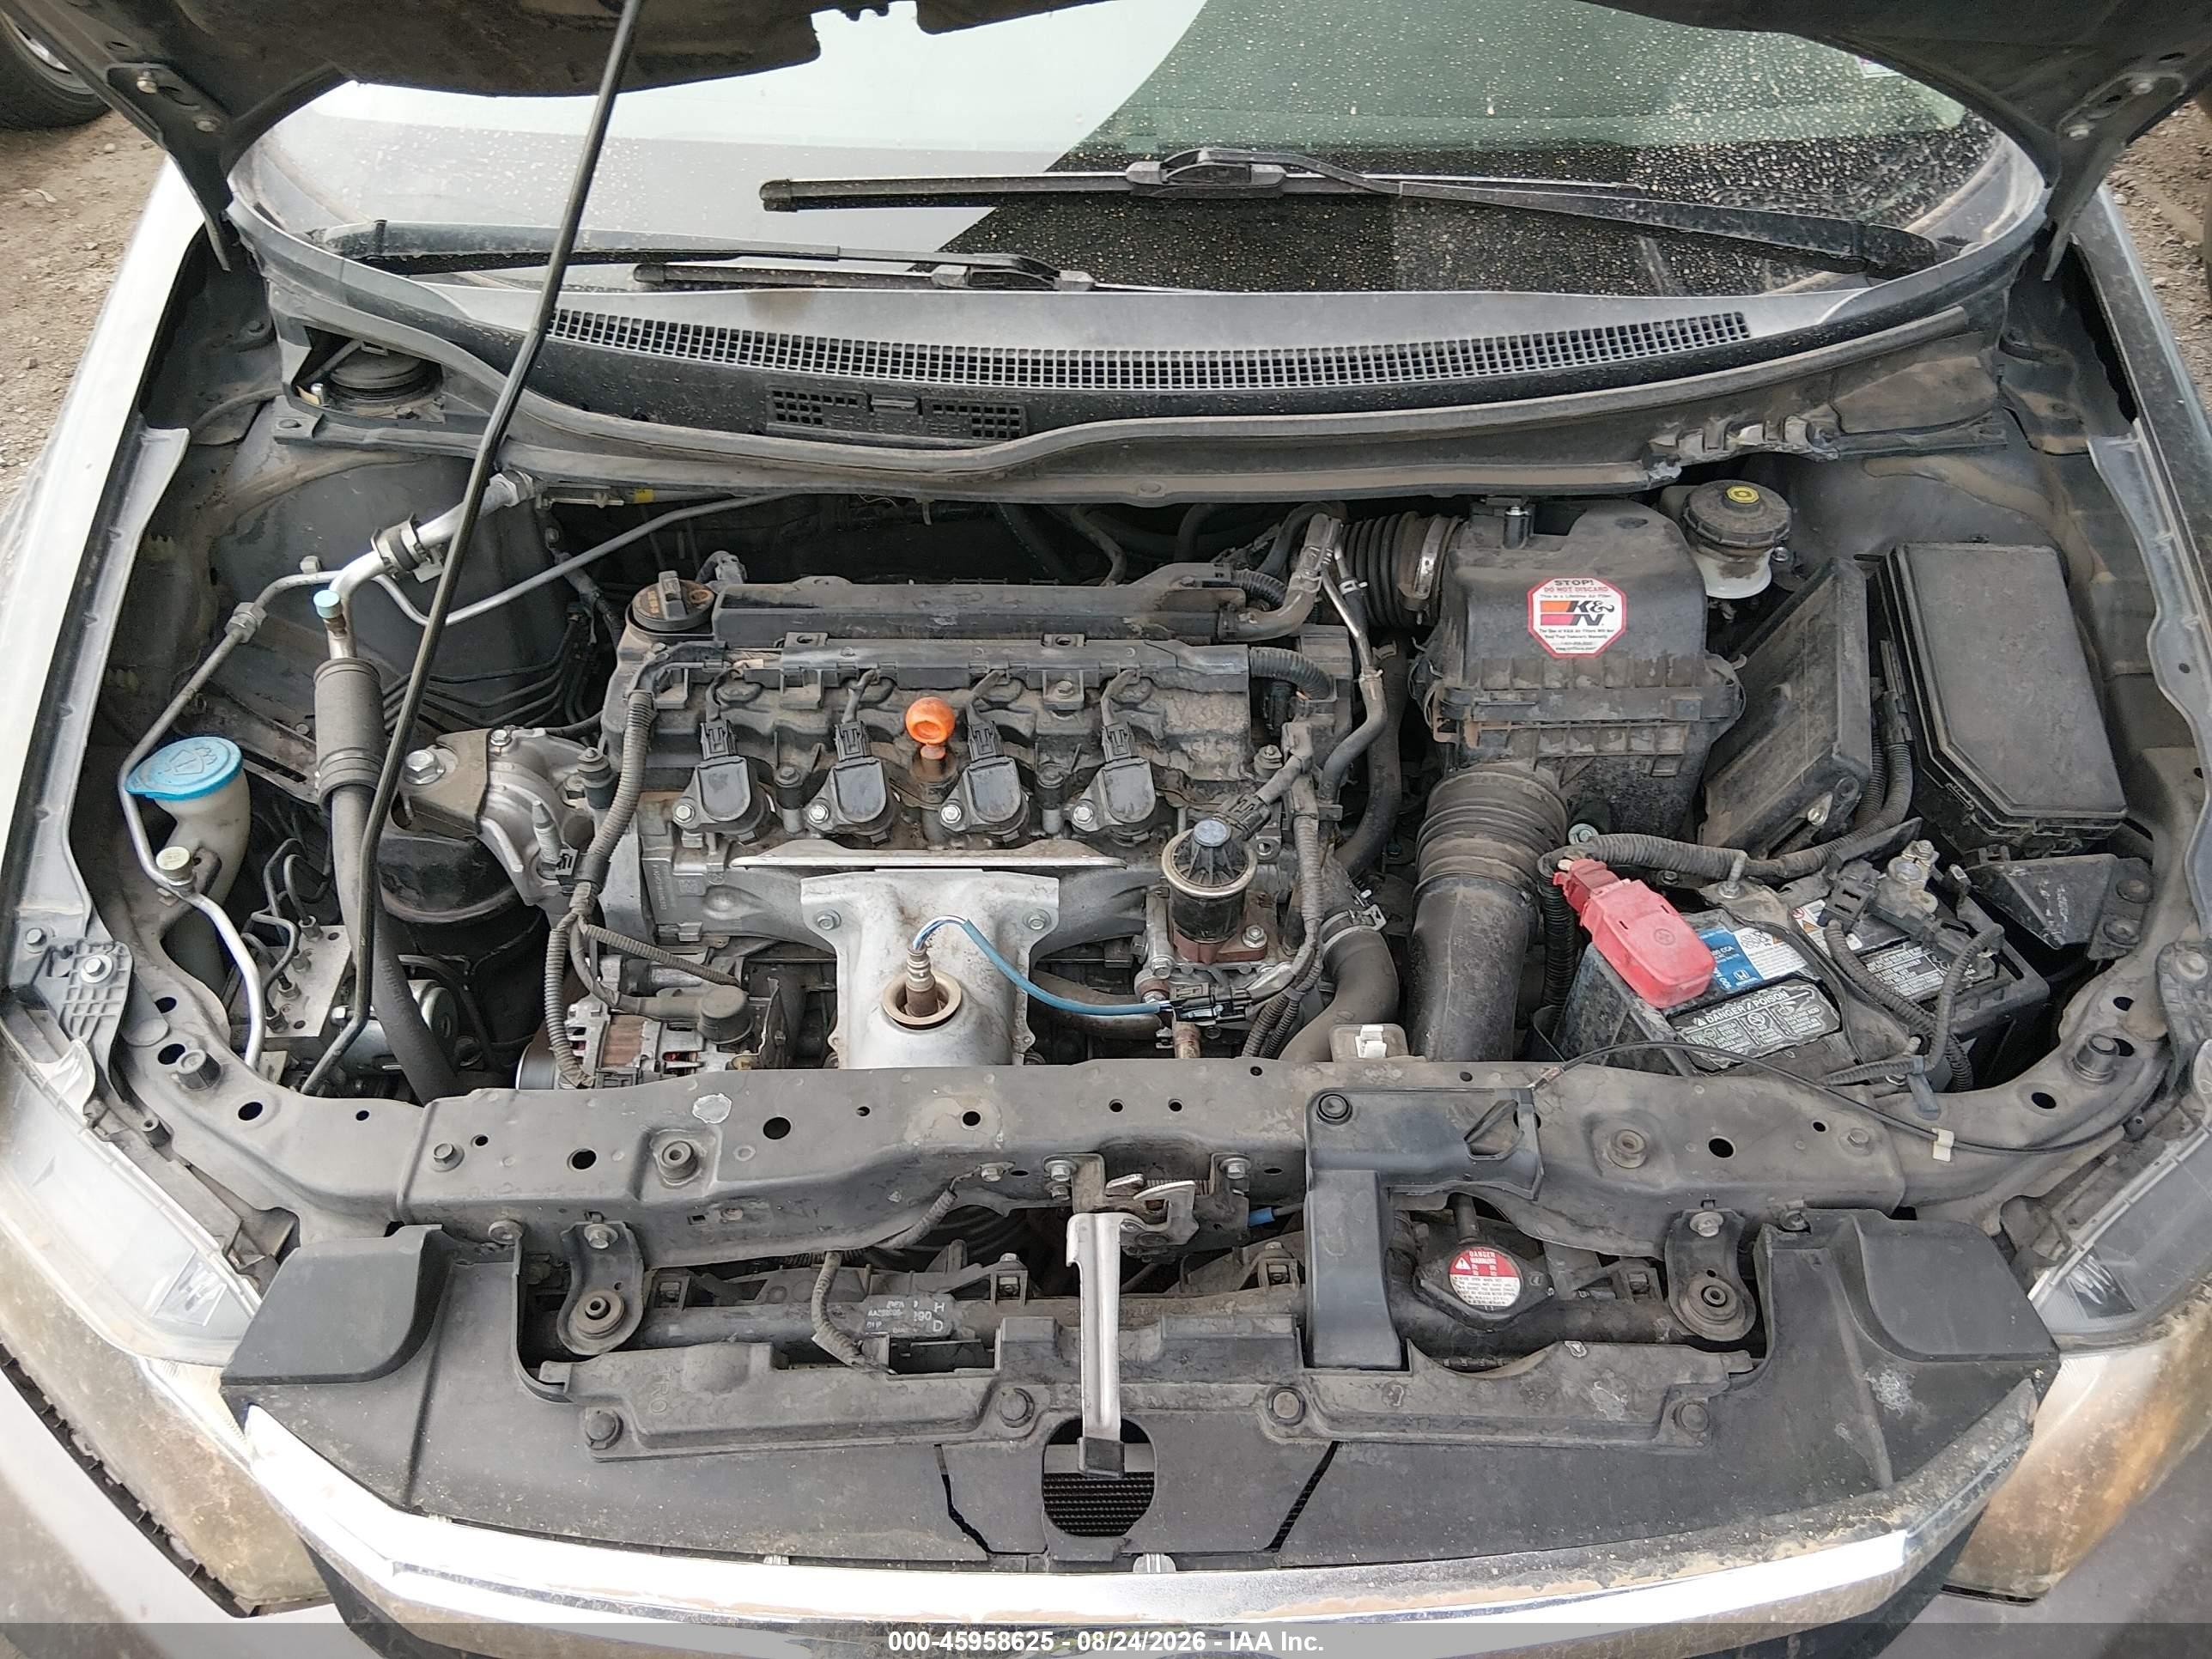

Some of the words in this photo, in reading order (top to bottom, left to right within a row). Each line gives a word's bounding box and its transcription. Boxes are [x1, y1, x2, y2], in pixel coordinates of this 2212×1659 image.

[1705, 1005, 1746, 1024] DANGER
[1753, 990, 1790, 1008] POISON
[934, 1302, 945, 1313] H
[933, 1320, 944, 1332] D
